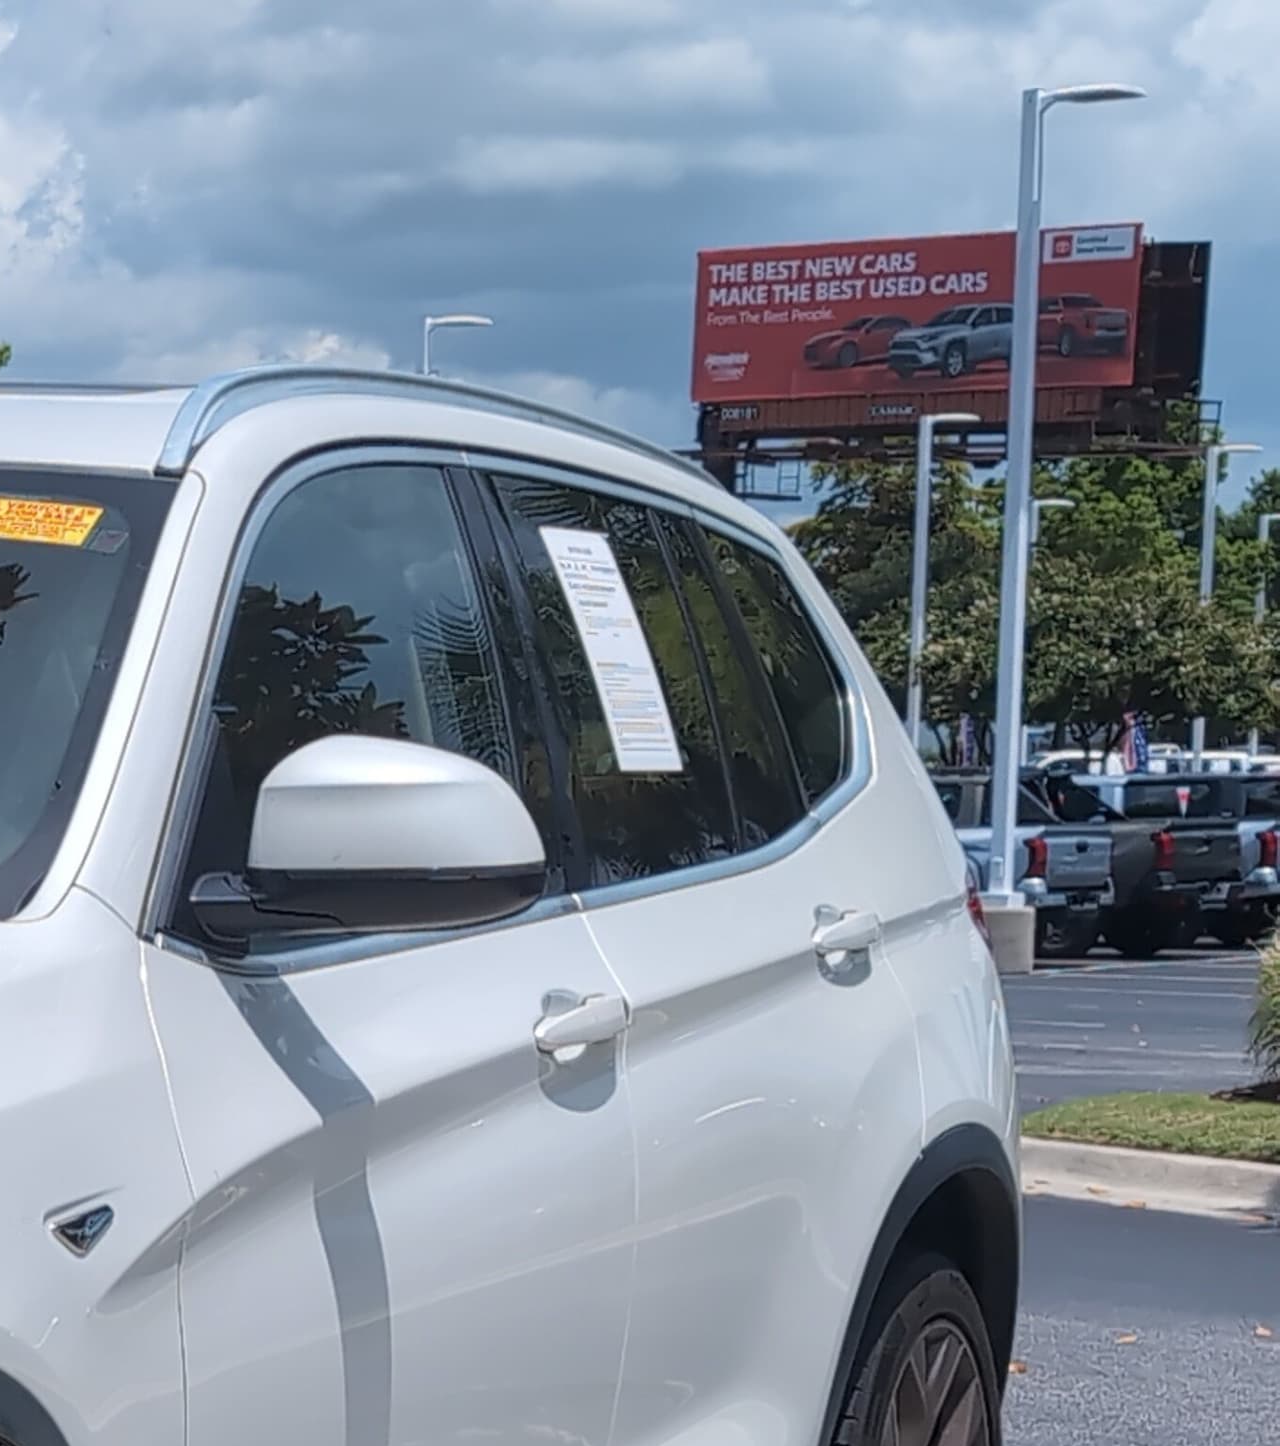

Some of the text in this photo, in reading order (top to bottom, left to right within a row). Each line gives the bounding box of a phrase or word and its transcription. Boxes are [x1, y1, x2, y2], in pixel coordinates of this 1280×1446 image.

[708, 251, 917, 284] THE BEST NEW CARS
[708, 271, 988, 307] MAKE THE BEST USED CARS
[707, 311, 737, 326] From
[739, 310, 760, 324] The
[762, 309, 789, 324] Best
